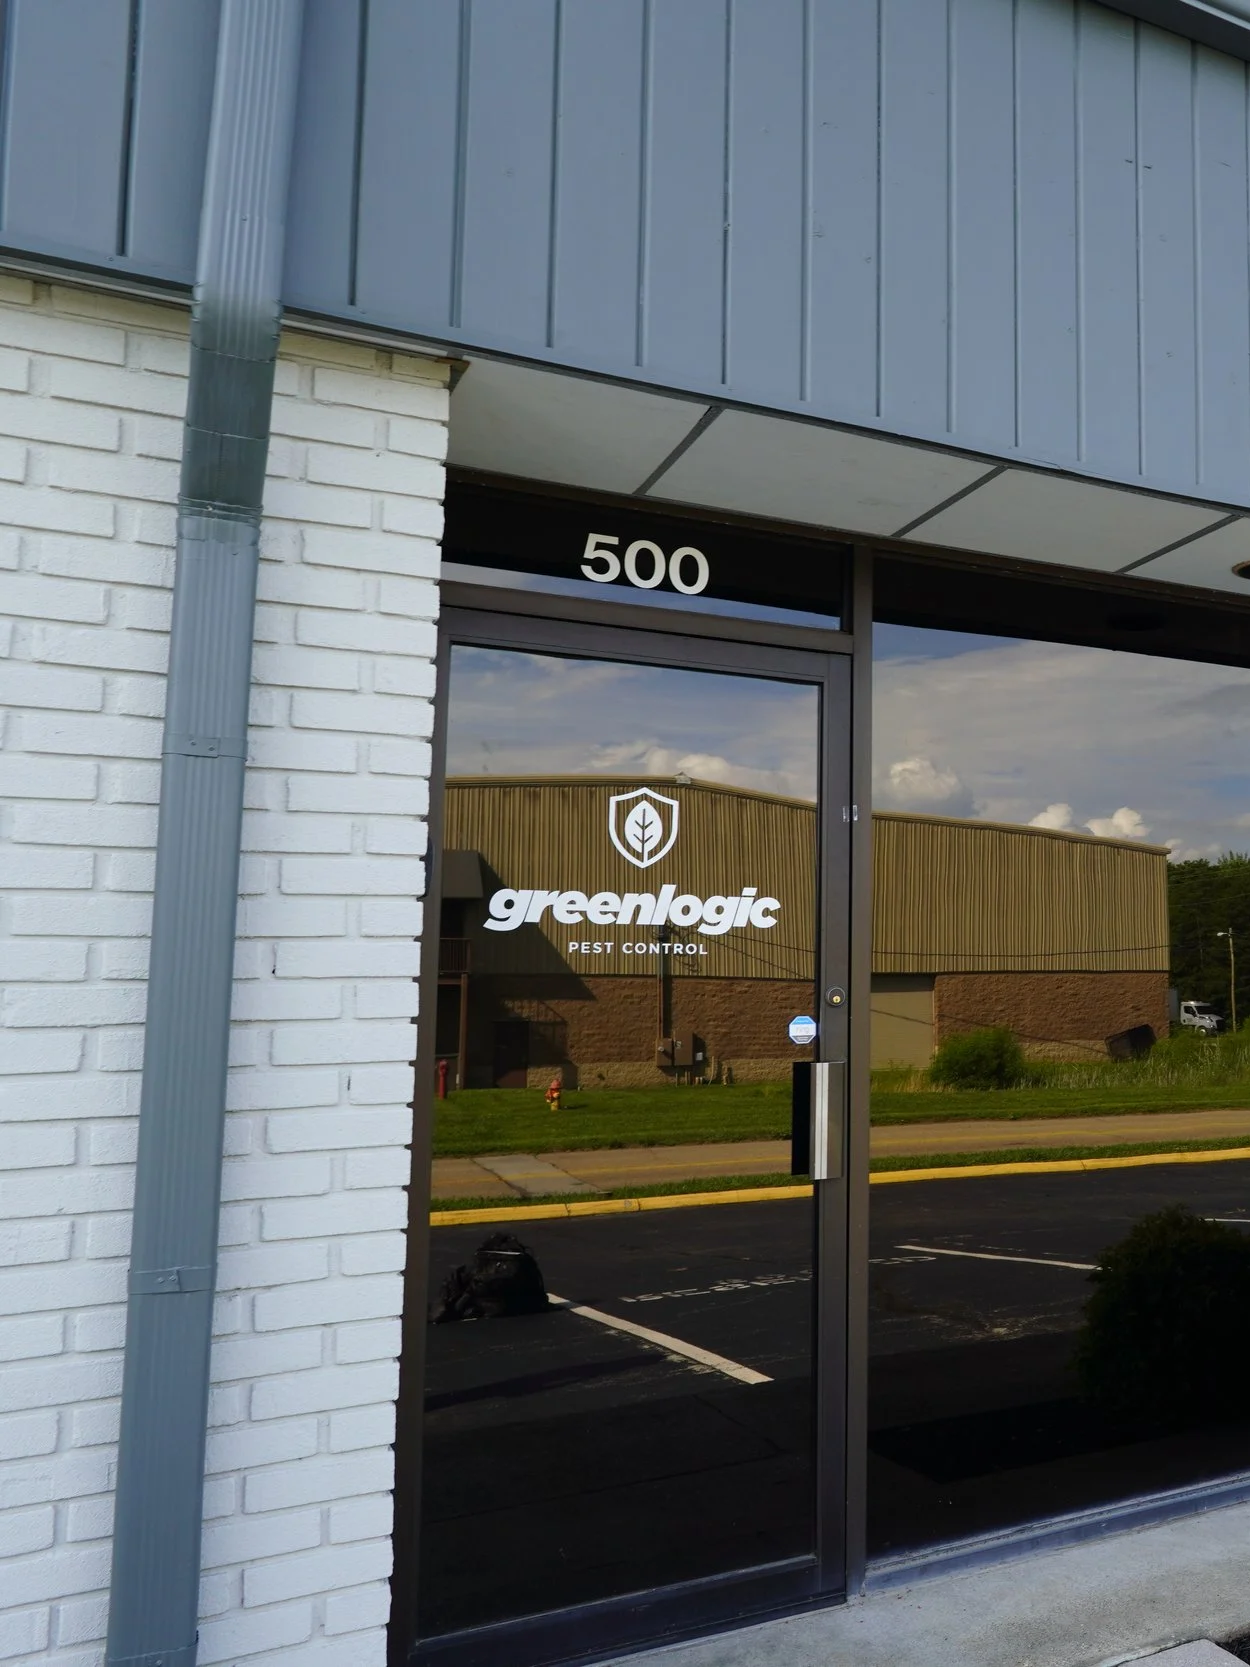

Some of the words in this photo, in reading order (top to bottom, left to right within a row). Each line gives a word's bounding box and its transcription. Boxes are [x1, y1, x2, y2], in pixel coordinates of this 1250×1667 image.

[581, 533, 710, 594] 500
[483, 884, 781, 935] greenlogic
[568, 941, 614, 954] PEST
[621, 942, 708, 955] CONTROL
